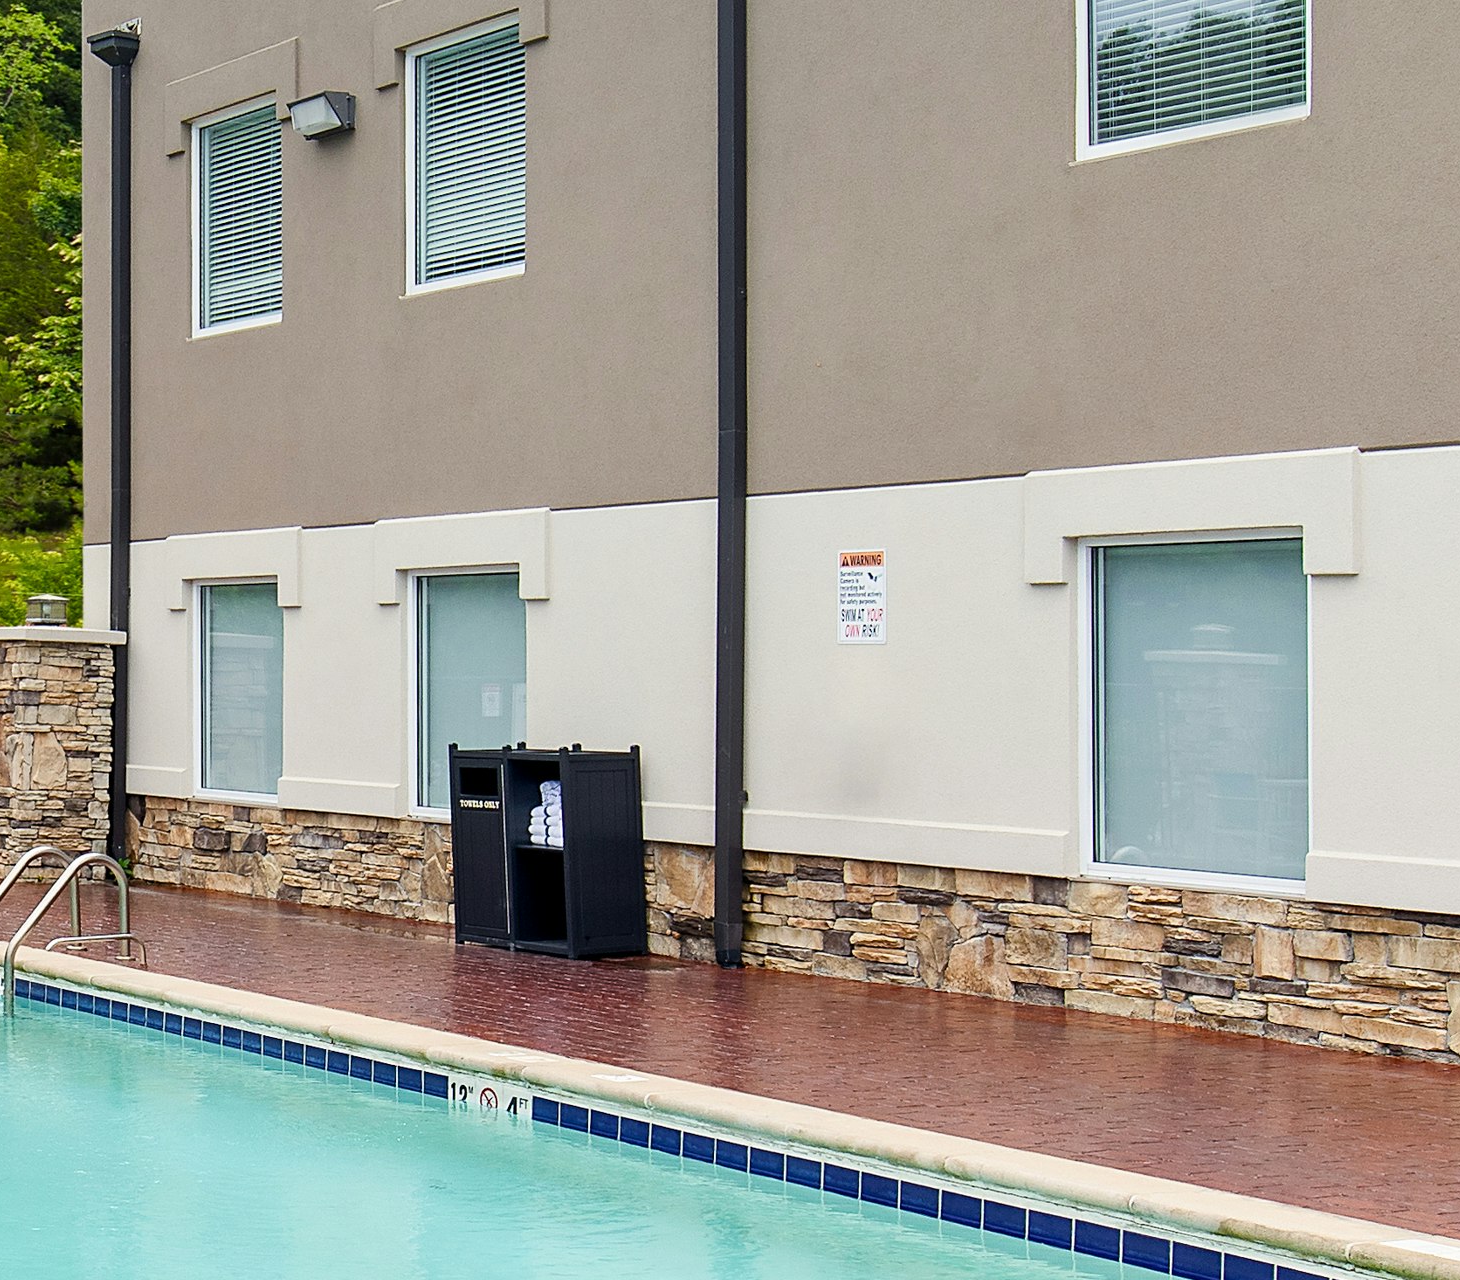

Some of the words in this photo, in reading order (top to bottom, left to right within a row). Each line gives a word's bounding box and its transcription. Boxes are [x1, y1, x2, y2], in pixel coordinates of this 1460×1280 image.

[850, 554, 882, 566] WARNING
[842, 608, 856, 622] SWIM
[858, 608, 864, 621] AT
[867, 608, 883, 622] YOUR
[845, 624, 860, 637] OWN
[459, 799, 483, 808] TOWELS
[484, 800, 500, 809] ONLY
